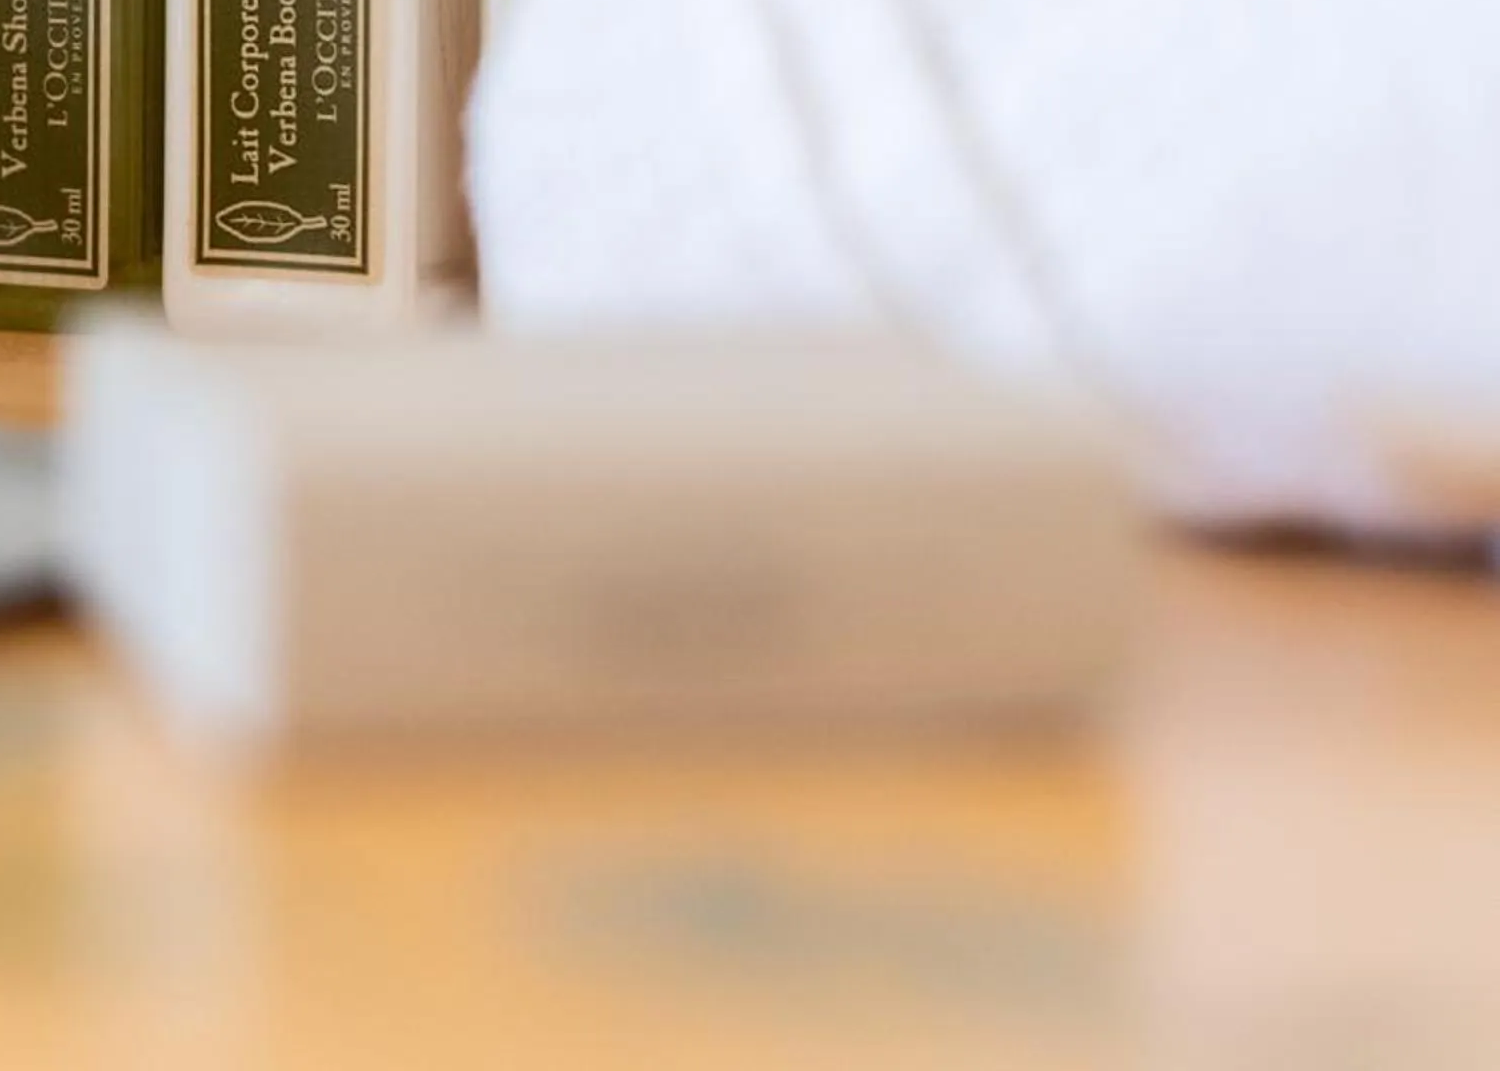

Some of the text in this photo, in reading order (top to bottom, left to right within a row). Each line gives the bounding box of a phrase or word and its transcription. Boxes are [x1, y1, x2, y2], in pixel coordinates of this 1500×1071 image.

[73, 72, 83, 94] EN
[341, 65, 351, 88] EN
[3, 63, 28, 177] Verbena
[270, 56, 296, 171] Verbena
[231, 129, 259, 184] Lait
[62, 189, 83, 246] 30 ml
[331, 184, 351, 241] 30 ml
